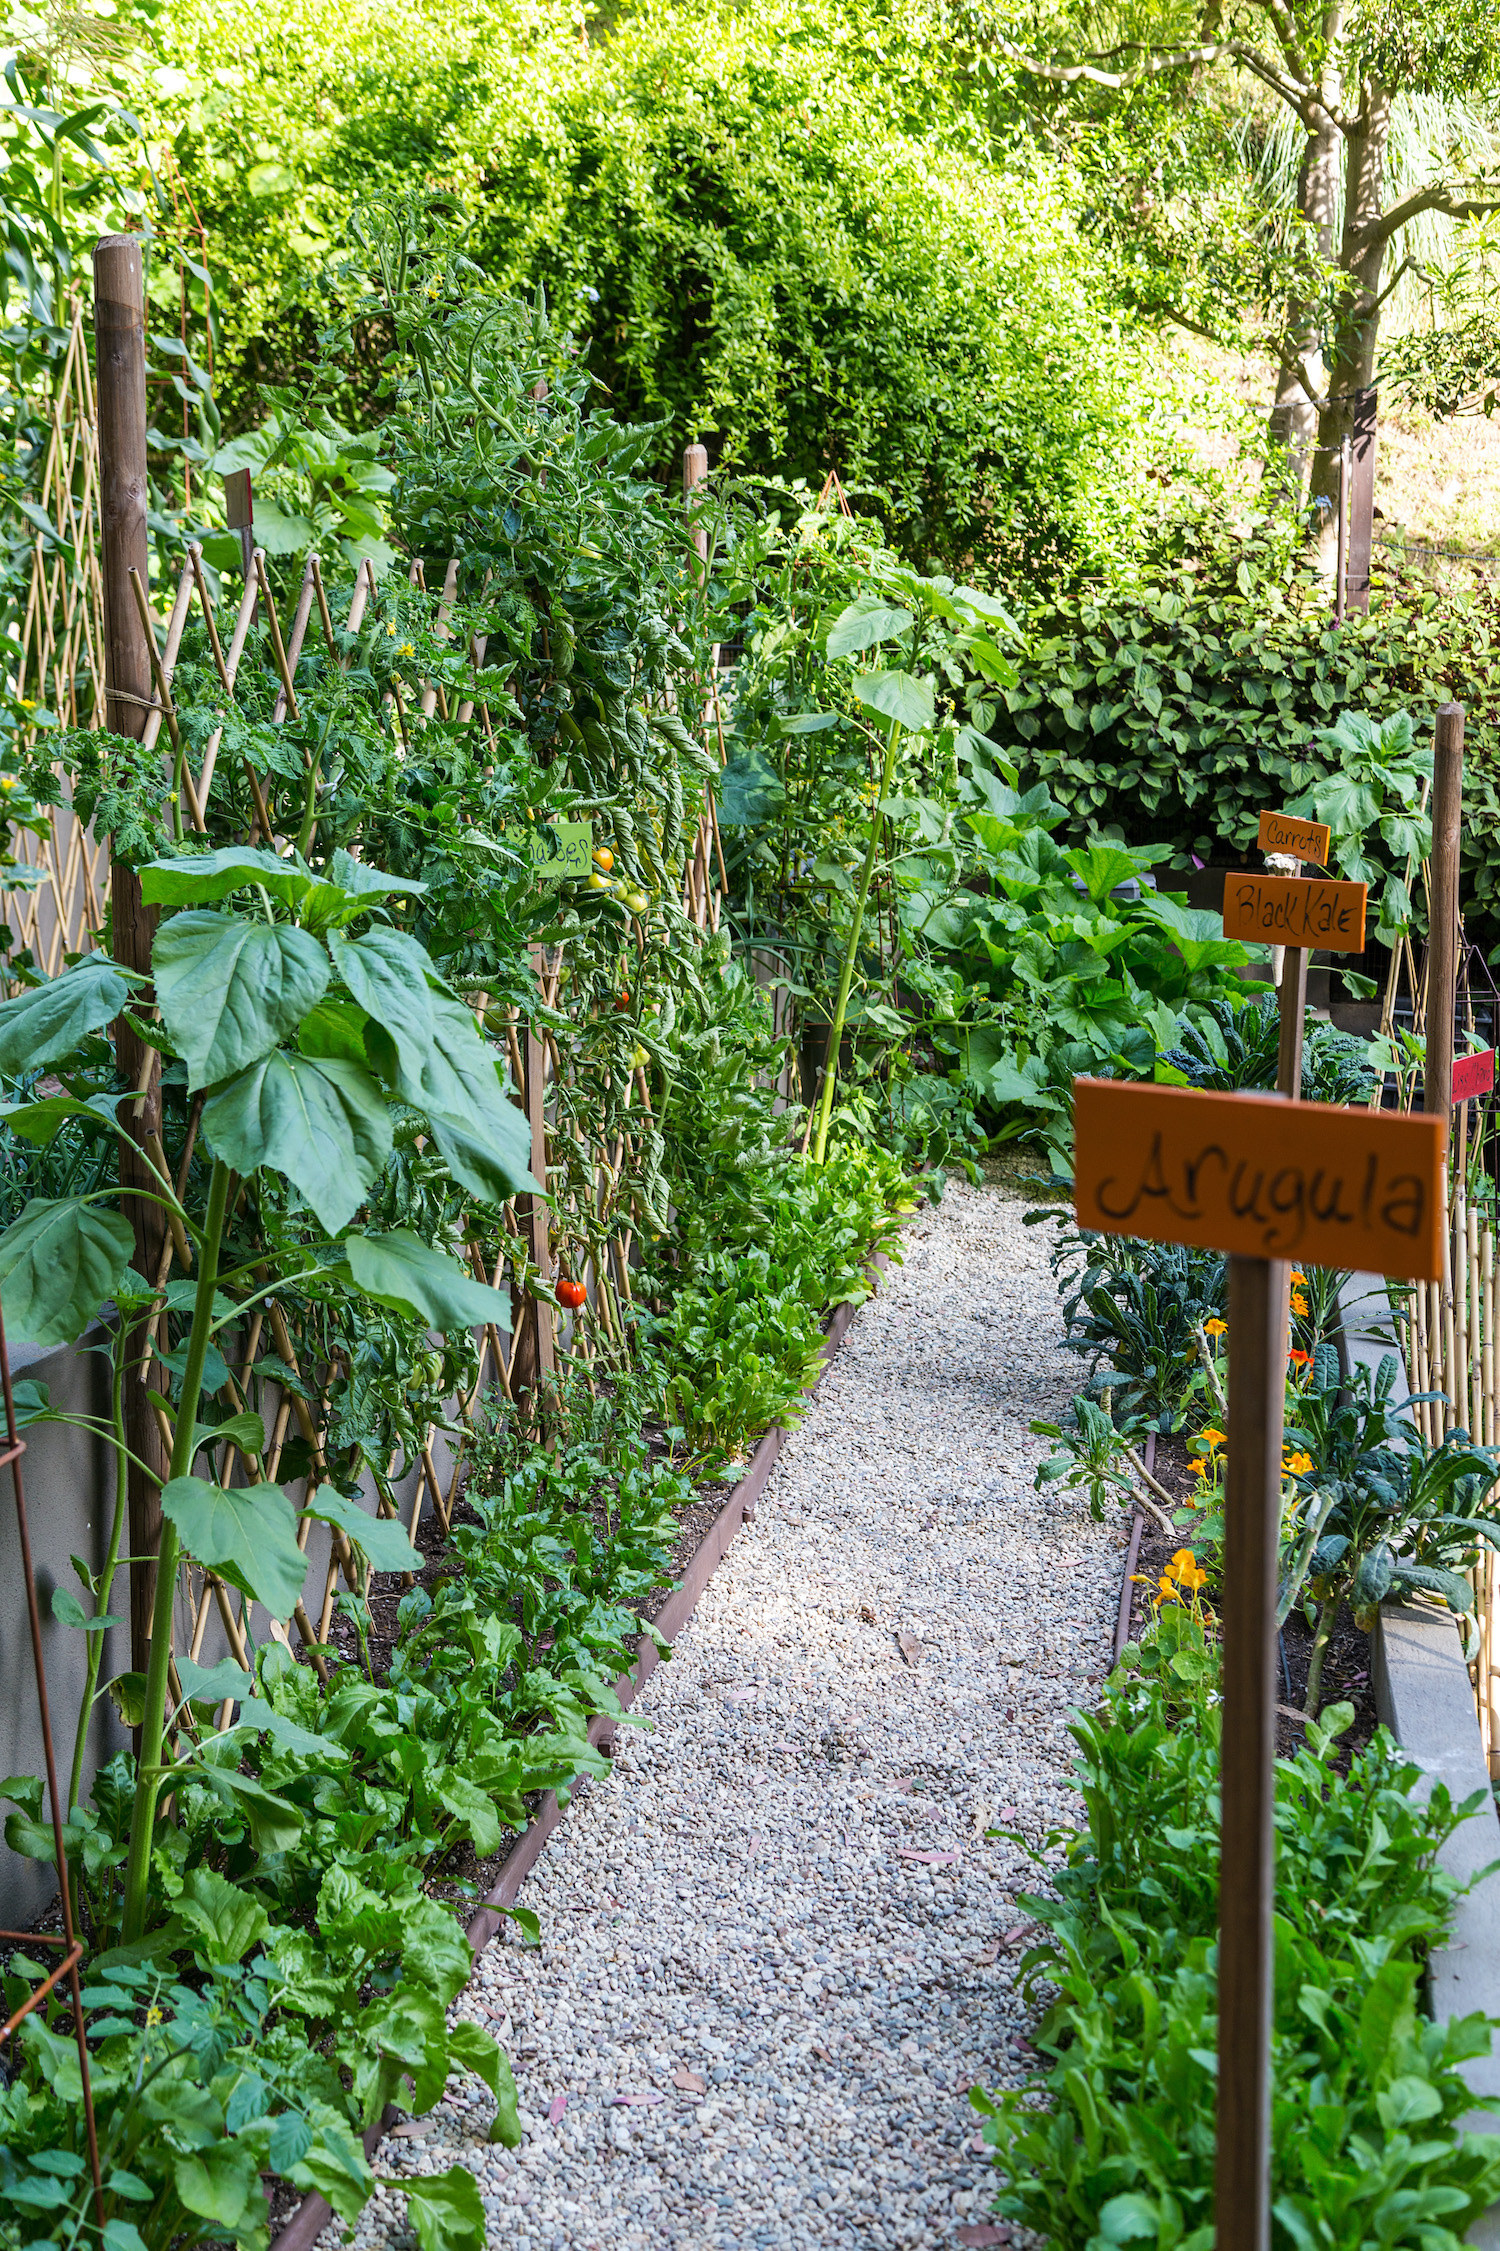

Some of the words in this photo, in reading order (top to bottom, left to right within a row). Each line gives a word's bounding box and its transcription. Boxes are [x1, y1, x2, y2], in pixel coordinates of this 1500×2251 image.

[1266, 819, 1322, 859] Carrots
[1236, 884, 1300, 937] Black
[1302, 884, 1358, 938] Kale
[1096, 1131, 1425, 1249] Arugula
